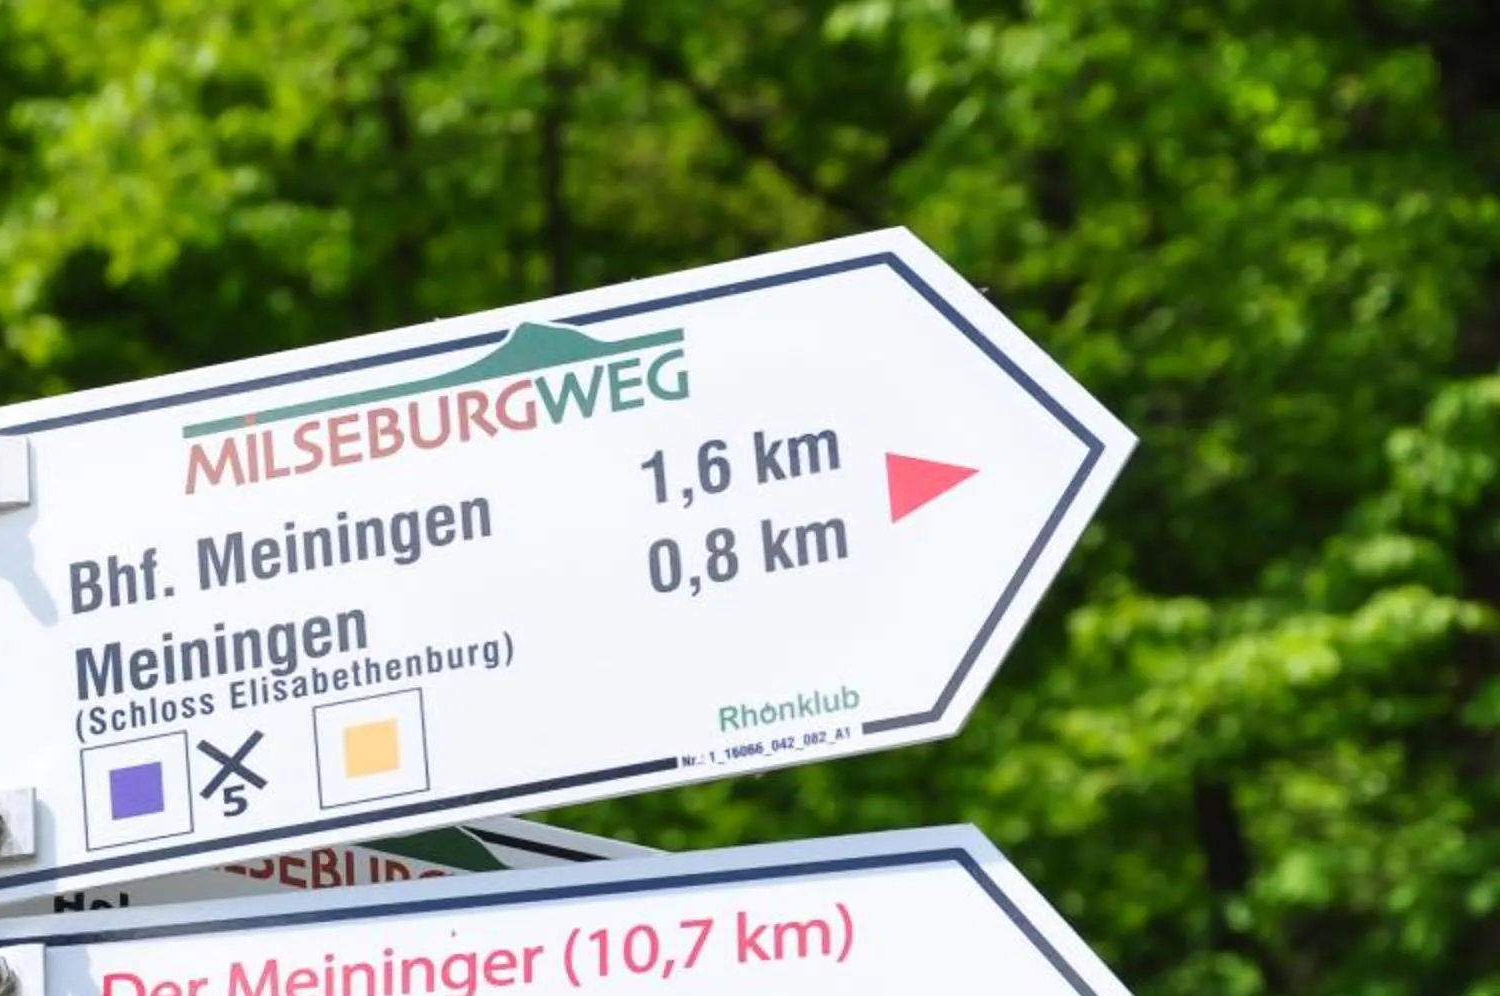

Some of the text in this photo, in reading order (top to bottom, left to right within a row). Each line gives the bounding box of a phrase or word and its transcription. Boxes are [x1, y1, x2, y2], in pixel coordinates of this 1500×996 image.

[185, 346, 690, 494] MILSEBURGWEG
[641, 429, 841, 509] 1,6 km
[69, 496, 493, 615] Bhf. Meiningen
[648, 518, 848, 597] 0,8 km
[75, 607, 368, 701] Meiningen
[75, 630, 515, 743] (Schloss Elisabethenburg)
[222, 784, 249, 817] 5
[564, 918, 714, 987] (10,7
[736, 902, 853, 964] km)
